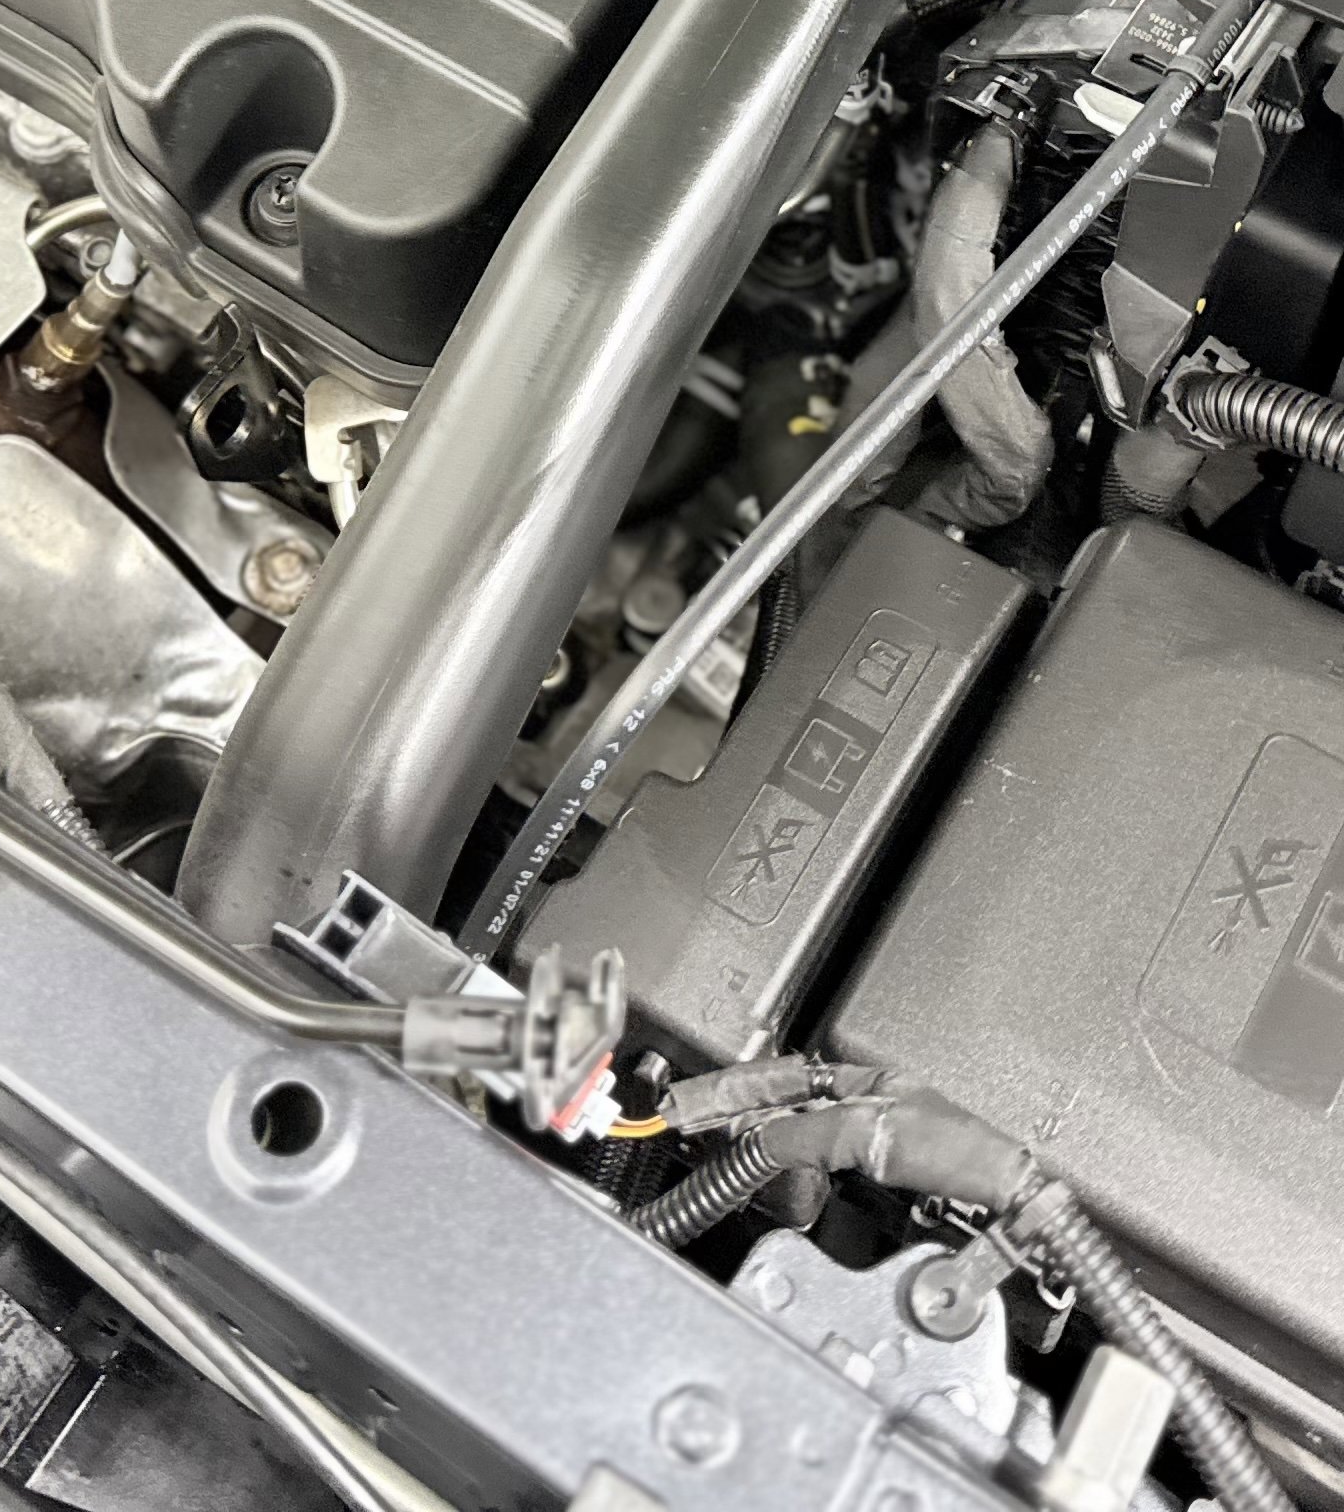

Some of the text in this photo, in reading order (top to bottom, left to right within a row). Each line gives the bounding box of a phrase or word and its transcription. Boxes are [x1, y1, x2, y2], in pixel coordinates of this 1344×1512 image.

[1065, 200, 1097, 236] 6x8
[578, 756, 611, 795] 6x8
[484, 867, 539, 939] 01/07/22
